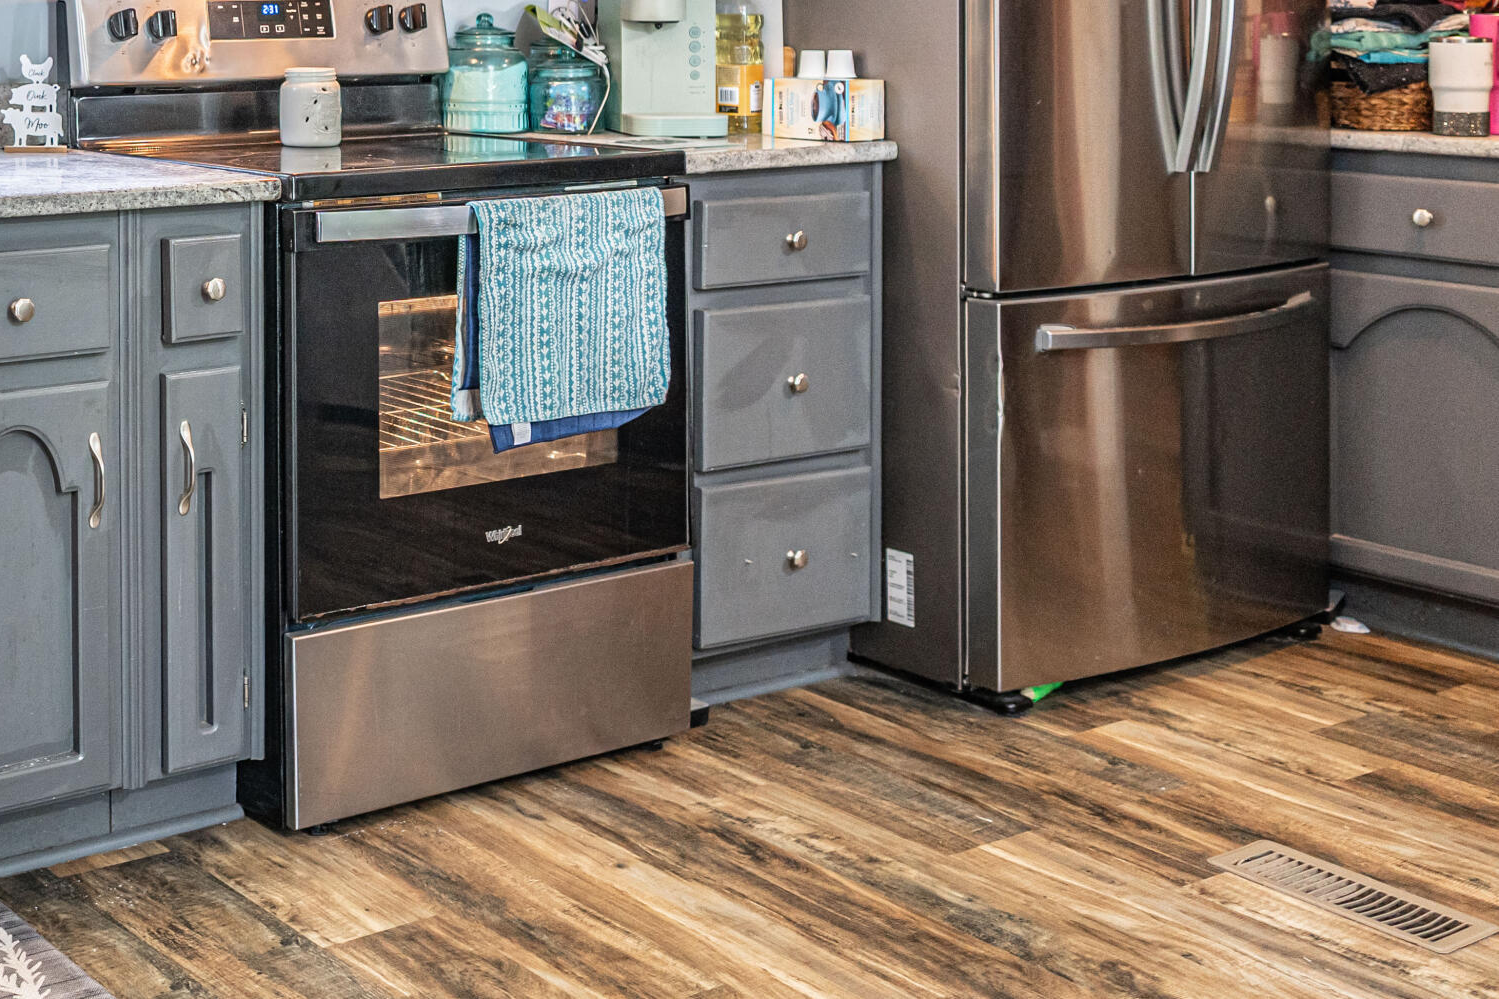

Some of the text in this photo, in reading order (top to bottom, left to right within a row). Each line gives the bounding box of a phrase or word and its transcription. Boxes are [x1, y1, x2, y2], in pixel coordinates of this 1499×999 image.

[262, 4, 279, 15] 2:31
[26, 89, 48, 102] Oink
[24, 116, 49, 132] Moo
